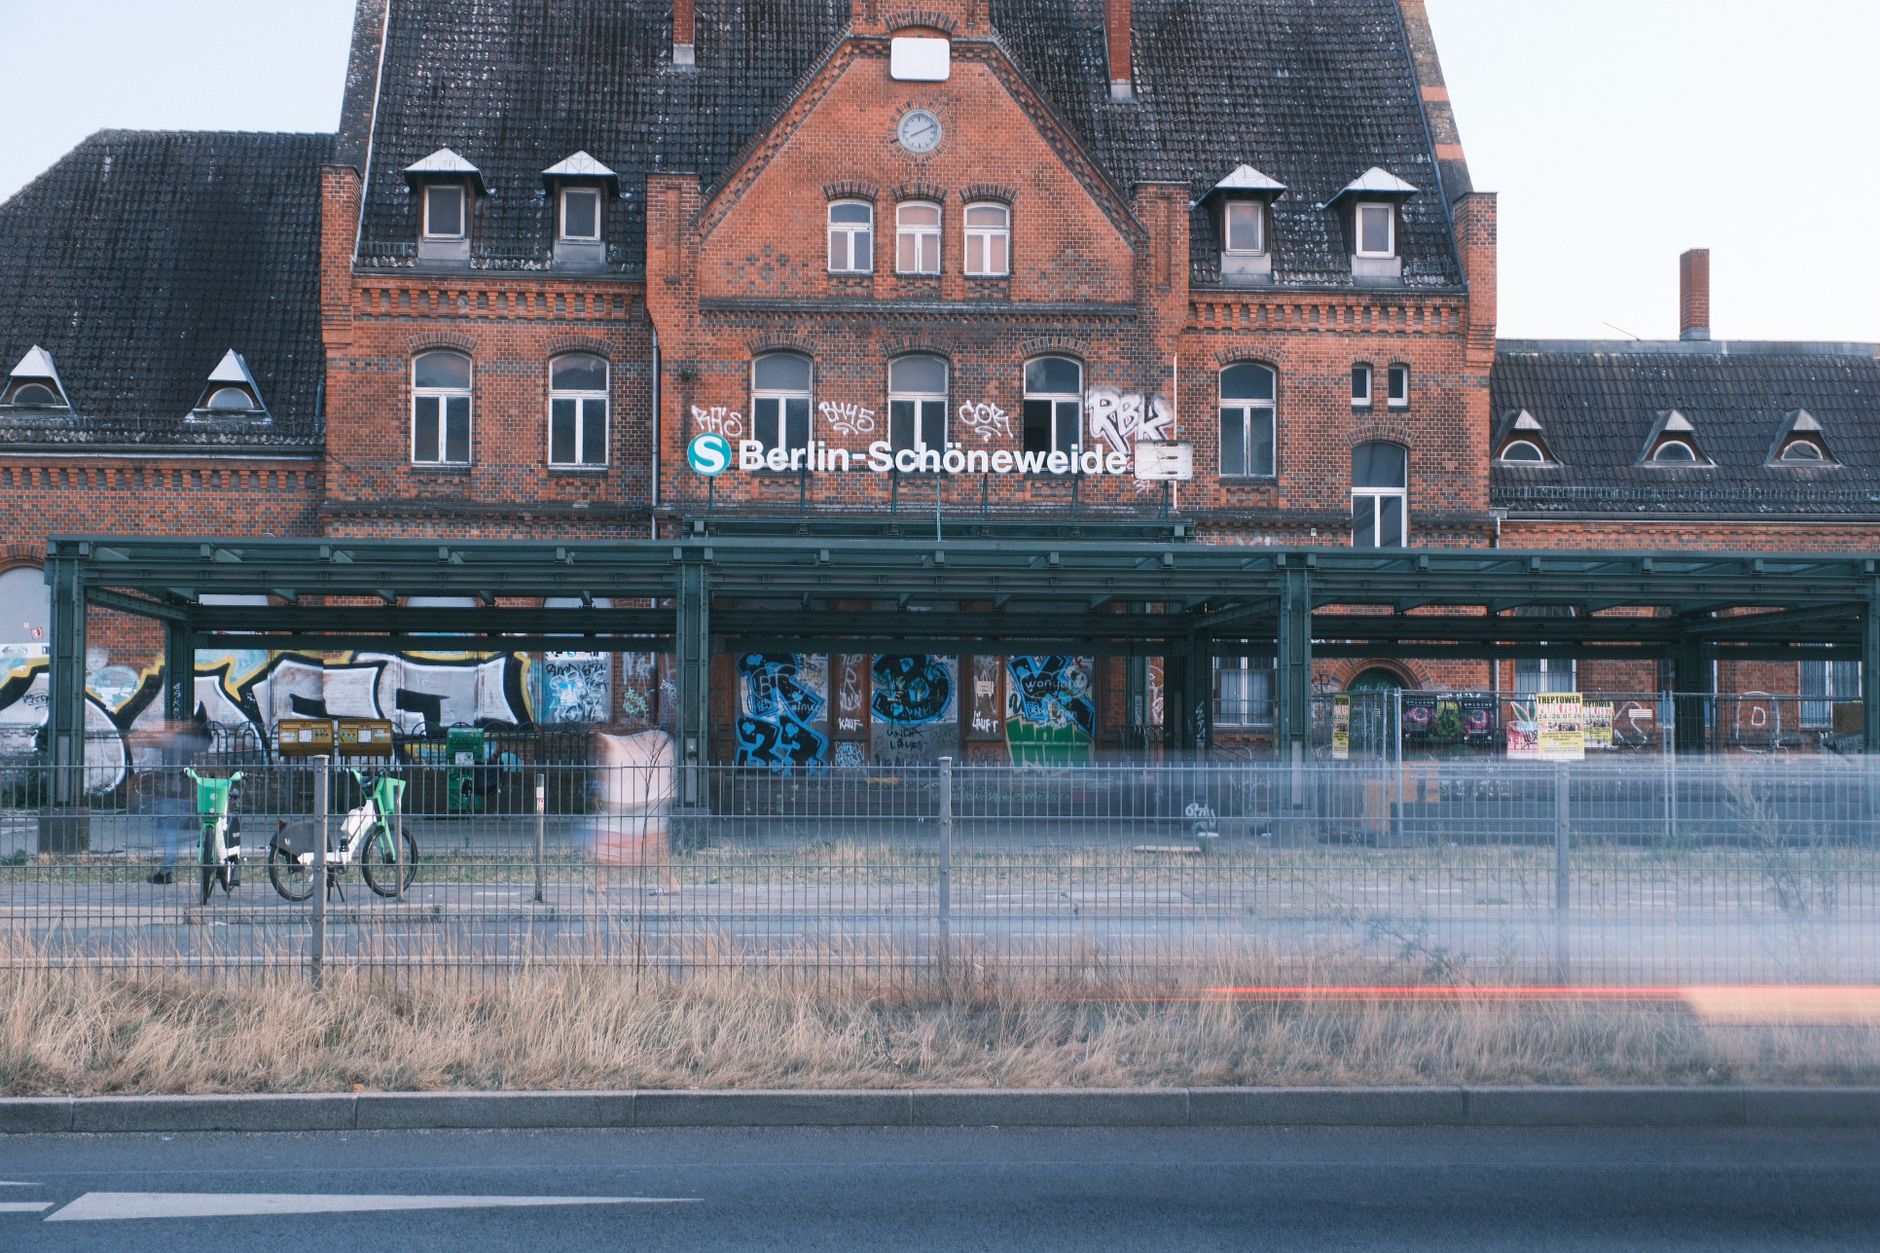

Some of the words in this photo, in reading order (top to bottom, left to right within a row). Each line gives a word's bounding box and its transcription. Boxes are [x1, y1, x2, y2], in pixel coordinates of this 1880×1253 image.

[692, 435, 727, 474] S
[738, 440, 1129, 473] Berlin-Schöneweide
[1538, 696, 1580, 704] TREPTOWER
[1538, 704, 1561, 714] PARK
[1562, 704, 1580, 714] FEST
